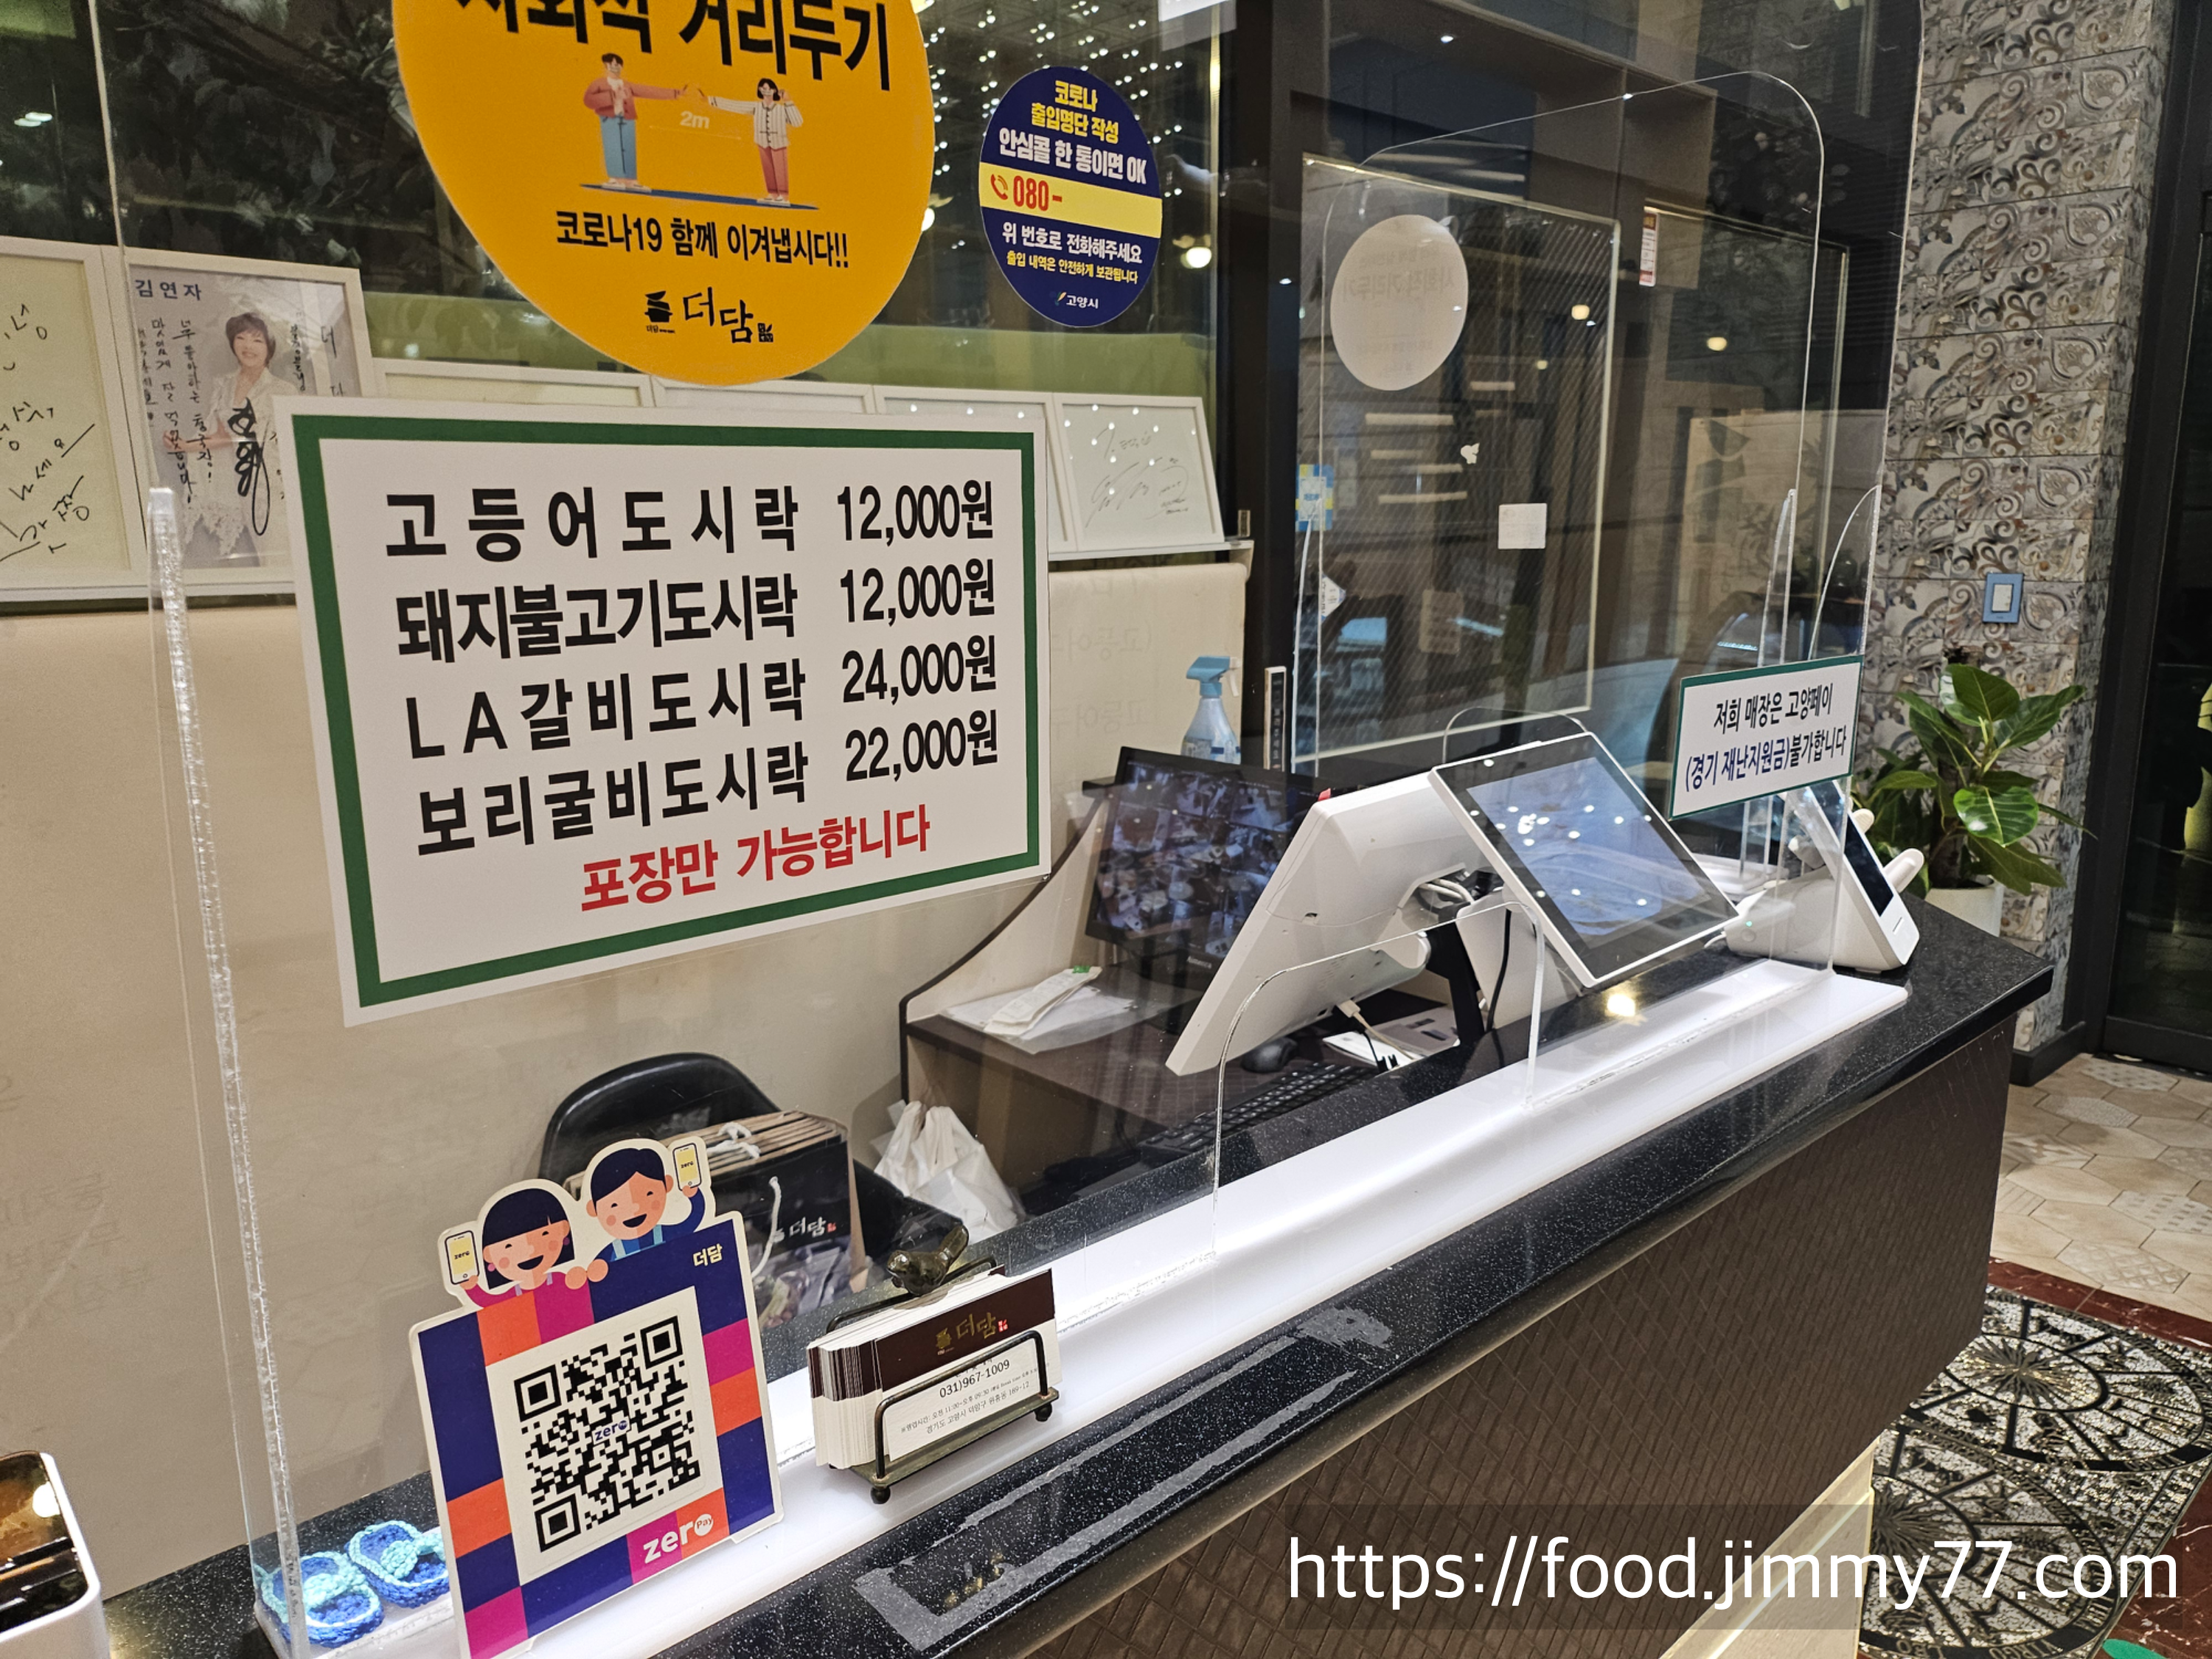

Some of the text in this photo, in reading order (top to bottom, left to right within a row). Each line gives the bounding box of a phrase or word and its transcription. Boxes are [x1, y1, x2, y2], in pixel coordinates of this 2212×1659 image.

[679, 0, 891, 91] 거리두기
[1054, 79, 1098, 113] 코로나
[679, 110, 710, 130] 2m
[1031, 102, 1119, 145] 출입명단 작성
[999, 127, 1147, 184] 안심콜 한 통이면 OK
[1013, 175, 1063, 212] 080-
[556, 210, 849, 268] 코로나19 함께 이겨냅시다!!
[1002, 221, 1143, 264] 위 번호로 전화해주세요
[1006, 249, 1138, 285] 출입 내역은 안전하게 보관됩니다
[683, 286, 754, 344] 더담
[1066, 295, 1099, 310] 고양시
[386, 479, 993, 563] 고등어도시락 12,000원
[395, 557, 995, 664] 돼지불고기도시락 12,000원
[842, 634, 996, 705] 24,000원
[1714, 683, 1833, 734] 저희 매장은 고양페이
[417, 709, 998, 856] 보리굴비도시락 22,000원
[1686, 751, 1719, 792] (경기
[581, 804, 931, 912] 포장만 가능합니다
[789, 1217, 827, 1238] 더담
[693, 1242, 723, 1267] 더담
[956, 1312, 996, 1339] 더담
[939, 1358, 1010, 1398] 031)967-1009
